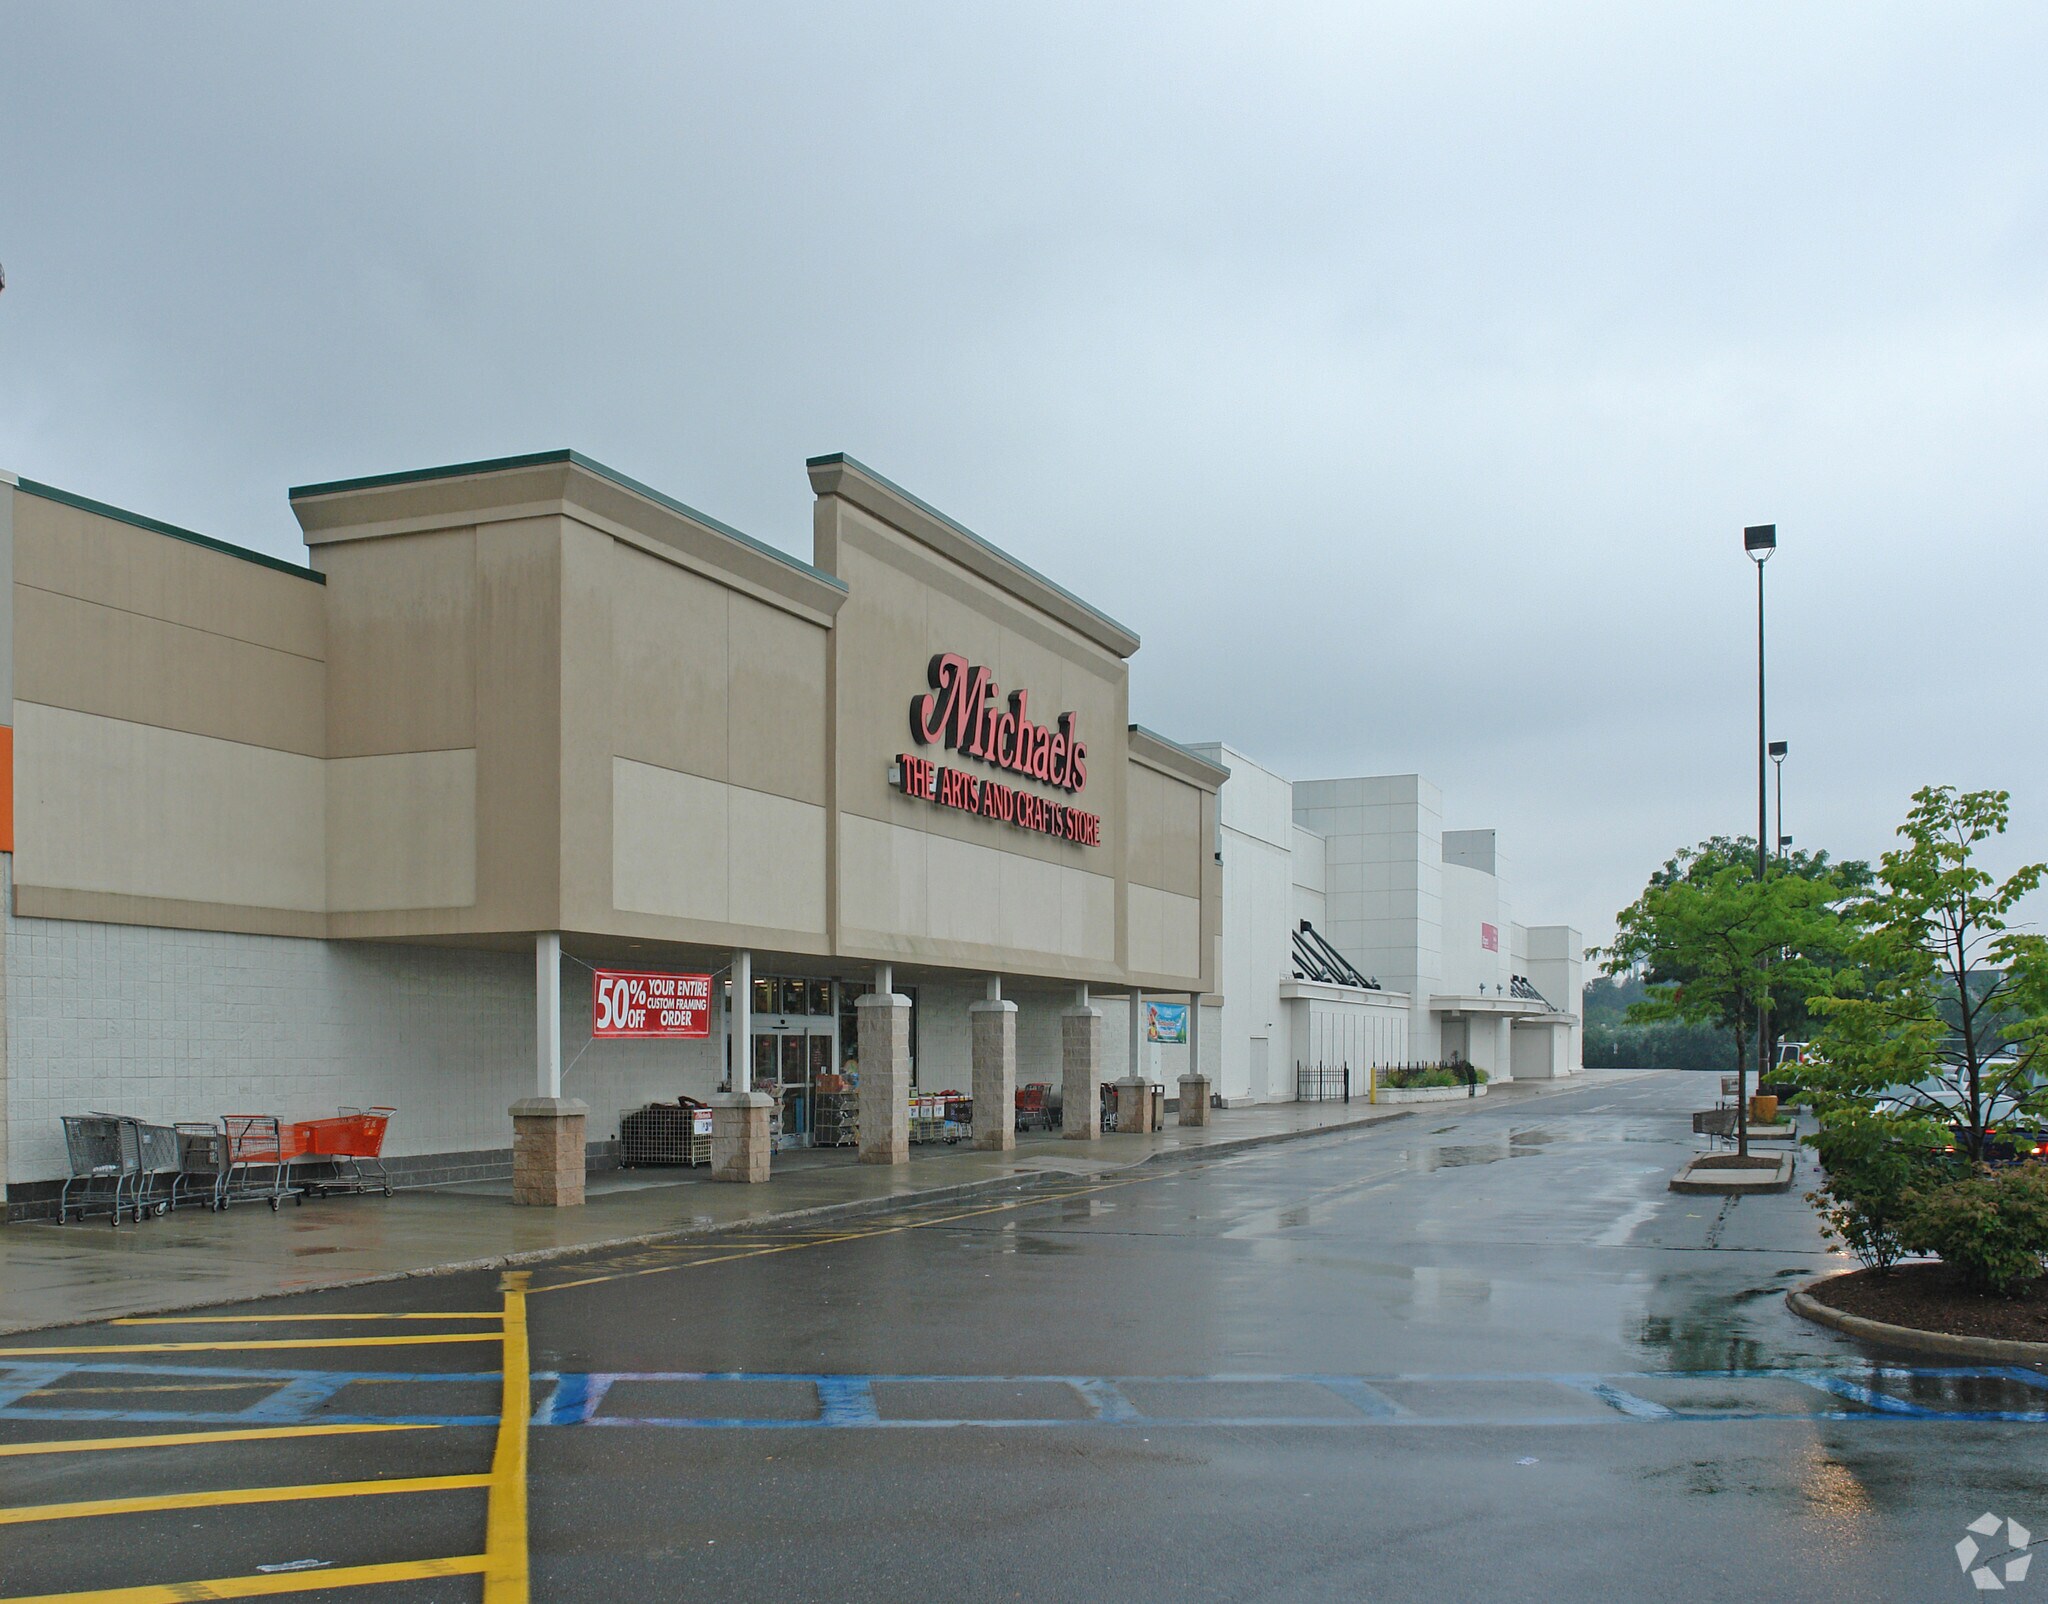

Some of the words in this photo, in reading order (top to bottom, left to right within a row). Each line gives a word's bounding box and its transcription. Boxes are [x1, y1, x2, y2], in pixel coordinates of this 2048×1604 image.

[911, 652, 1087, 793] Michaels
[899, 753, 936, 801] THE
[939, 766, 979, 813] ARTS
[981, 780, 1014, 821] AND
[1014, 790, 1063, 837] CRAFTS
[1064, 806, 1100, 847] STORE
[648, 979, 675, 996] YOUR
[677, 981, 707, 997] ENTIRE
[597, 978, 646, 1029] 50%
[647, 997, 674, 1009] CUSTOM
[676, 999, 706, 1011] FRAMING
[628, 1009, 646, 1028] OFF
[660, 1010, 692, 1026] ORDER
